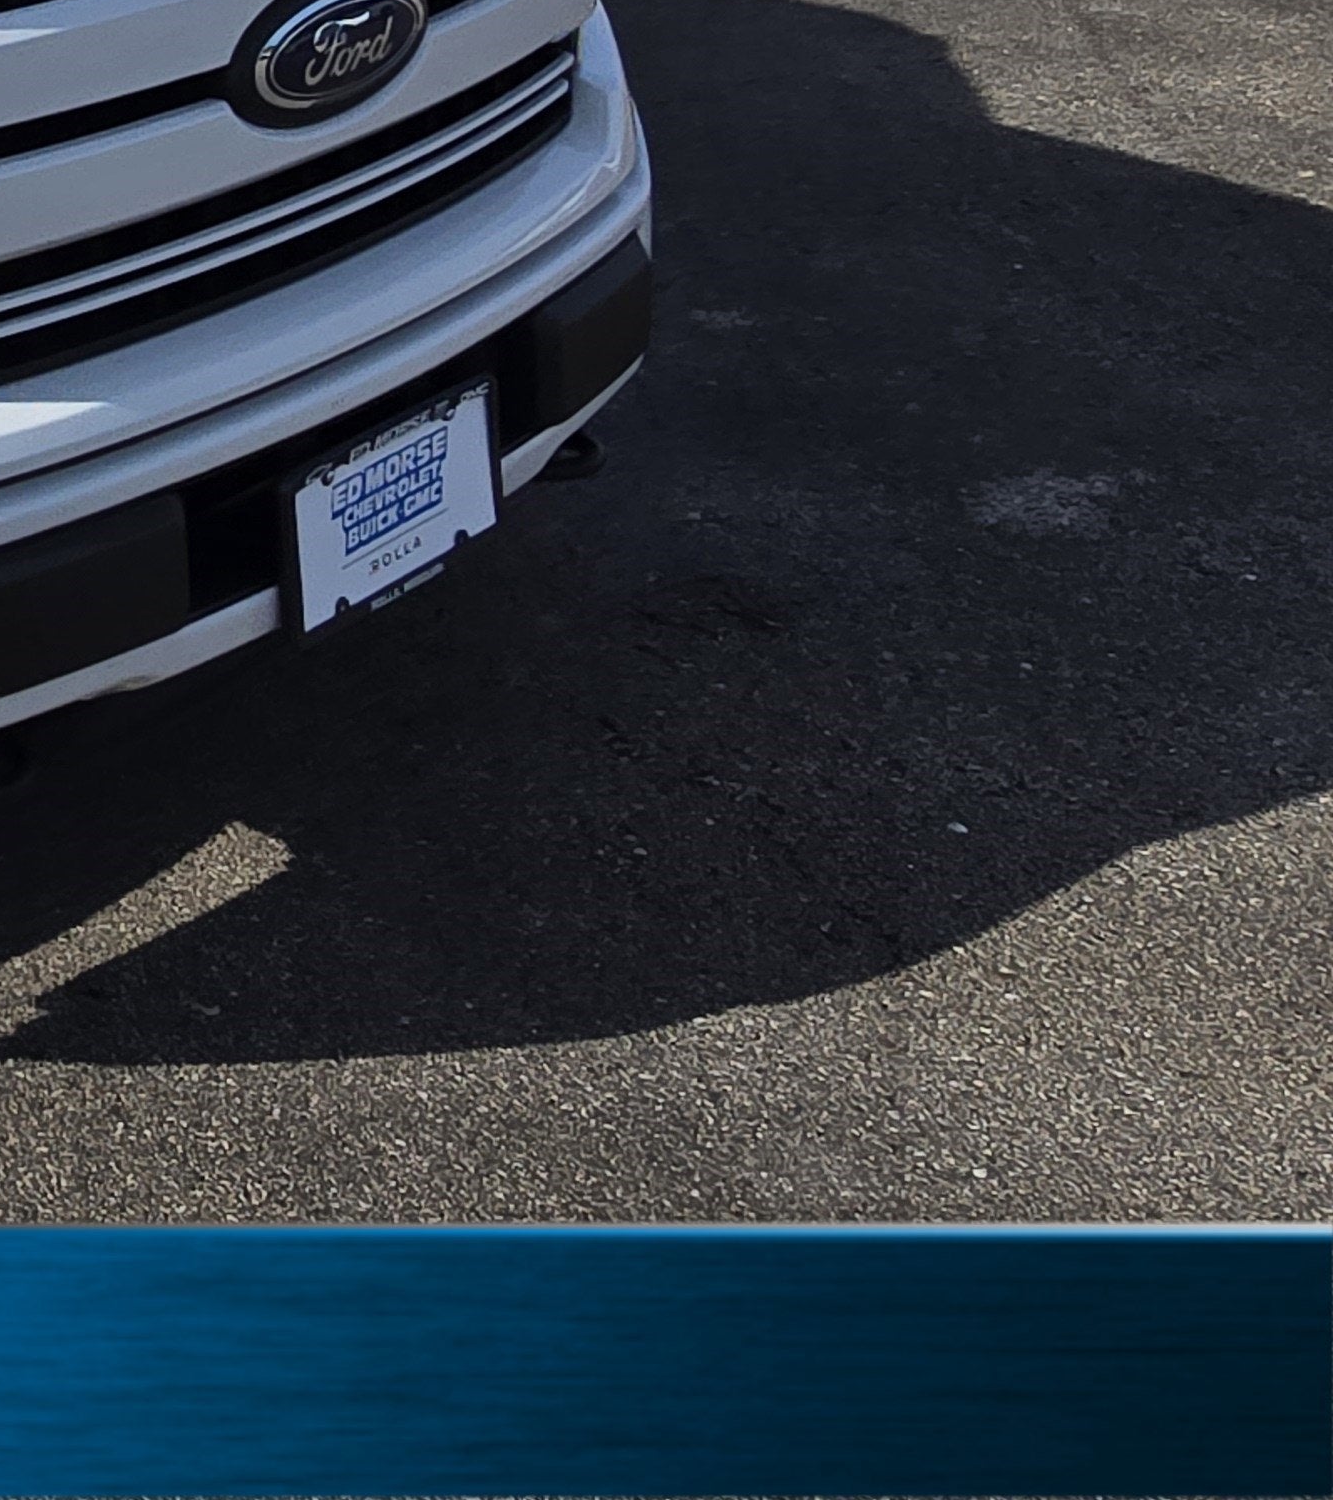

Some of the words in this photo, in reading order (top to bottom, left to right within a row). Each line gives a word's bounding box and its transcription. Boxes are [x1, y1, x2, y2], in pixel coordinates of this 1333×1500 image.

[304, 10, 393, 86] Ford
[333, 474, 363, 512] ED
[365, 428, 447, 495] MORSE
[343, 463, 442, 529] CHEVROLET
[369, 535, 422, 576] ROLLA
